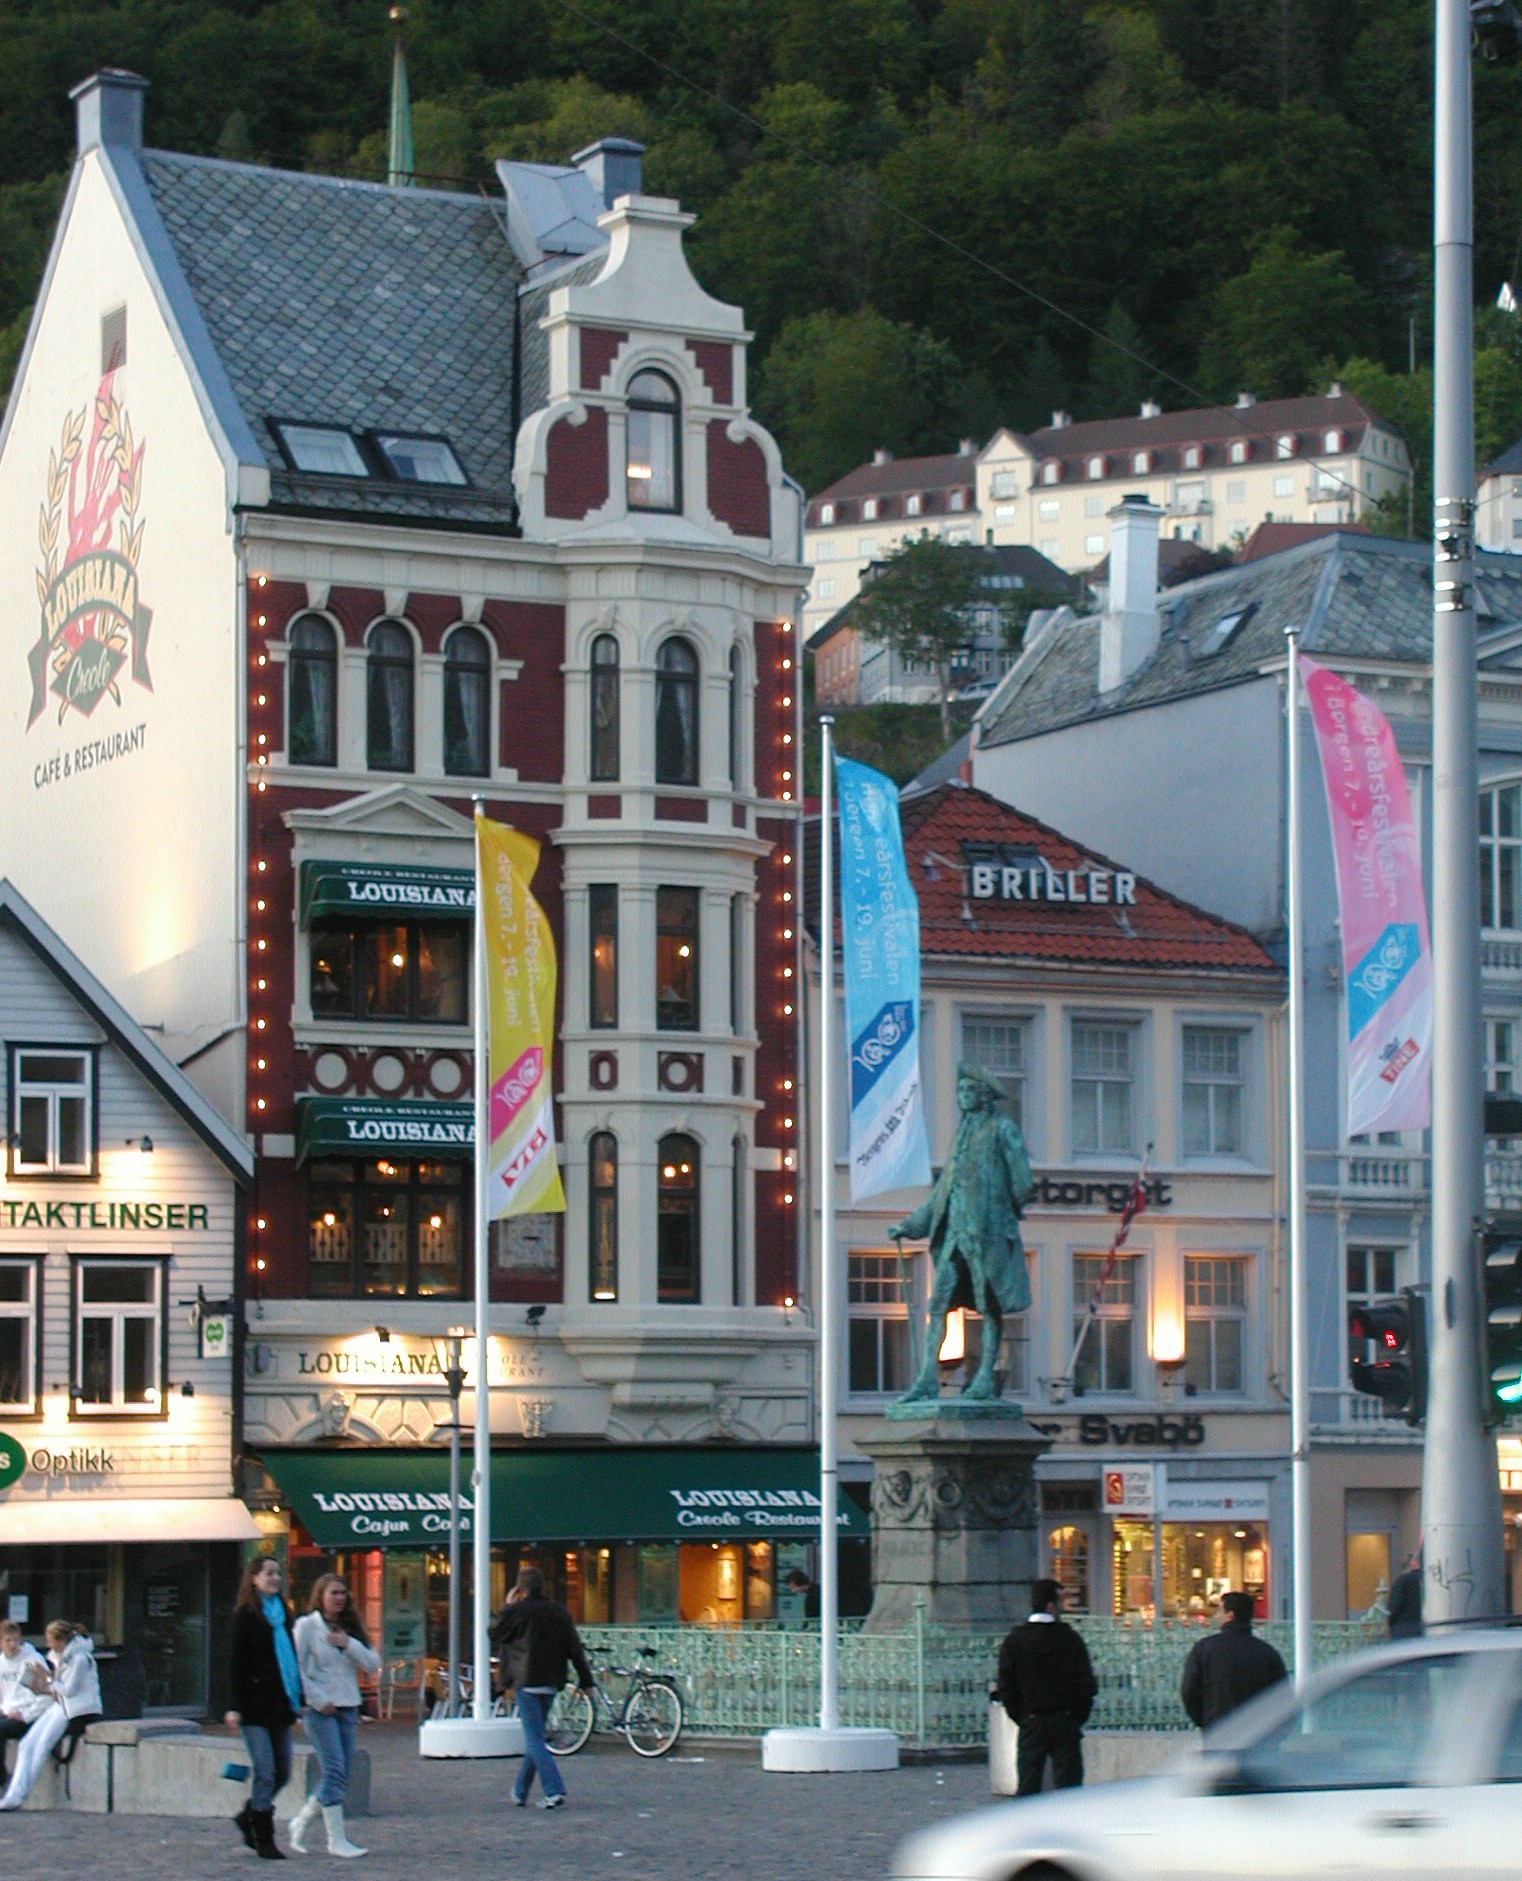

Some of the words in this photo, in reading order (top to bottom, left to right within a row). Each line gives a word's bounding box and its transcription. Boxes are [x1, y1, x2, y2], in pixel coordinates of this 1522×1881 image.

[44, 559, 136, 643] LOUISIANA
[34, 748, 61, 790] CAFÉ
[64, 752, 71, 778] &
[74, 722, 147, 774] RESTAURANT
[348, 881, 475, 906] LOUISIANA
[972, 866, 1136, 905] BRILLER
[856, 903, 873, 932] 19.
[854, 936, 880, 979] juni
[347, 1120, 475, 1143] LOUISIANA
[4, 1200, 209, 1229] TAKTLINSER
[298, 1352, 444, 1375] LOUISIANA
[32, 1448, 114, 1477] Optikk
[312, 1493, 475, 1511] LOUISIANA
[670, 1490, 822, 1507] LOUISIANA
[351, 1514, 409, 1537] Cajun
[677, 1510, 741, 1527] Creole
